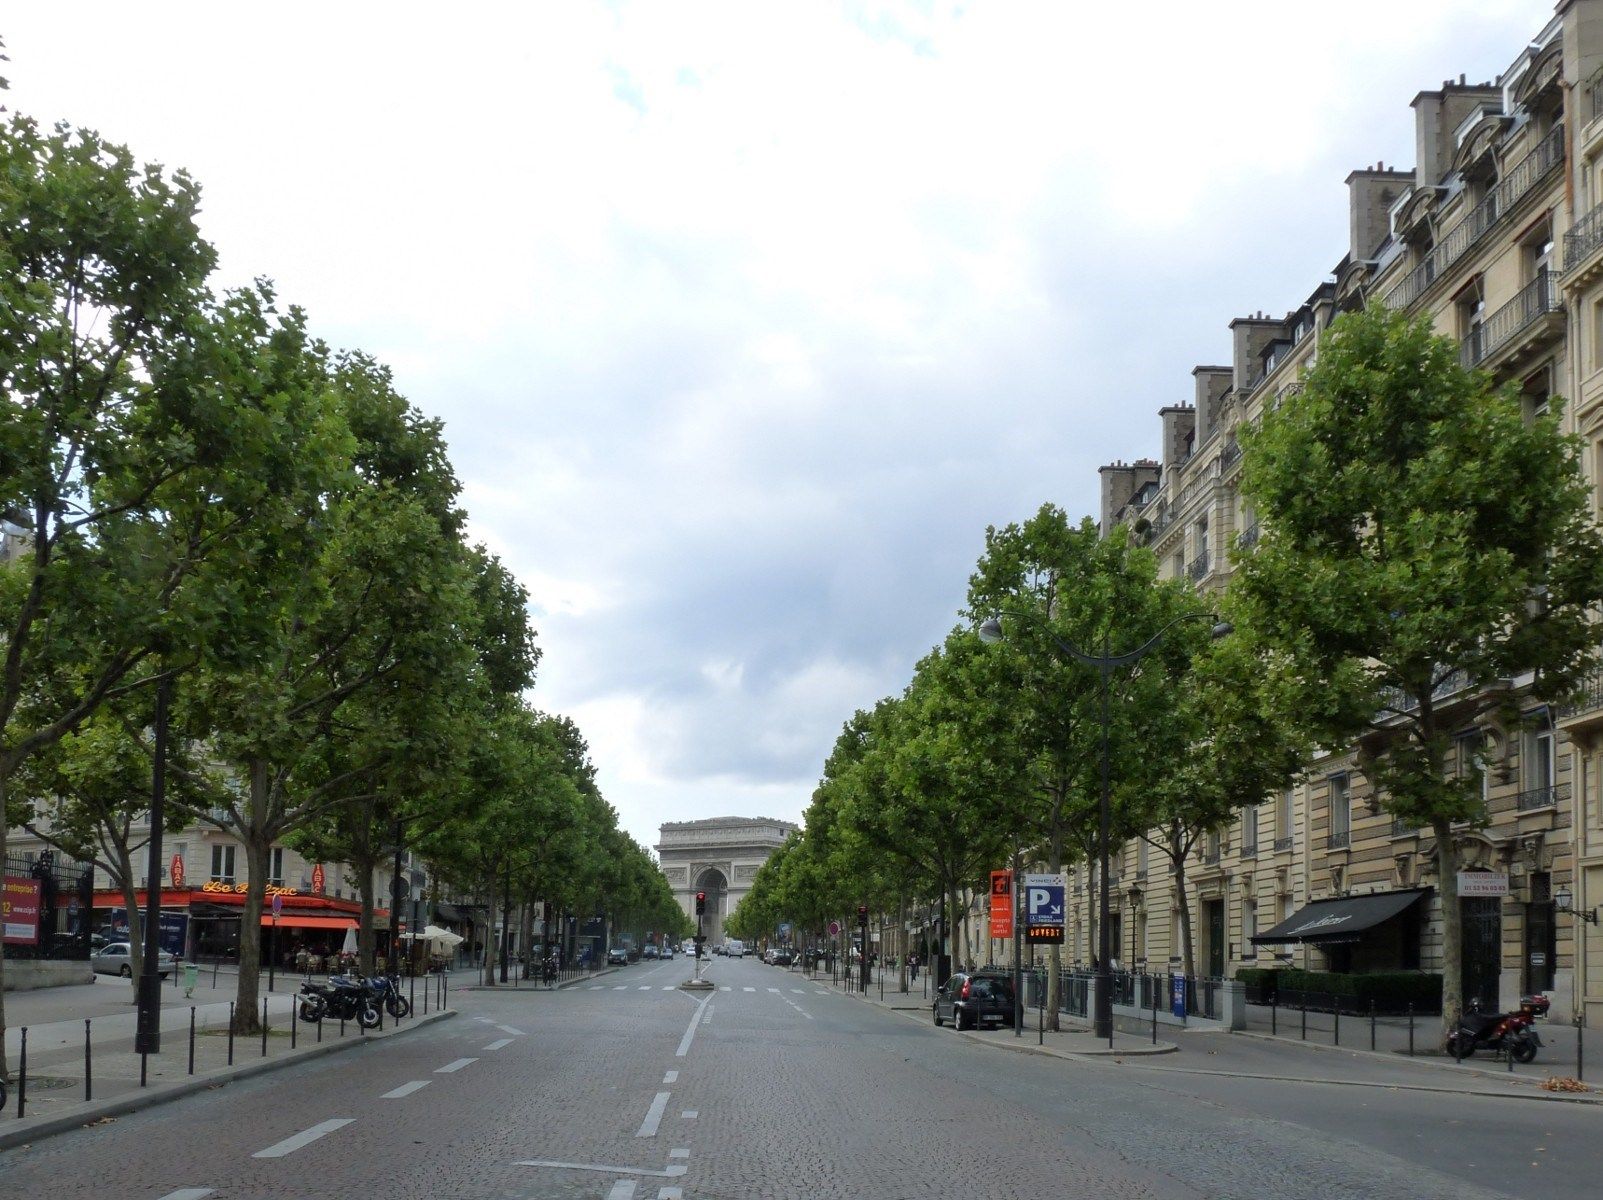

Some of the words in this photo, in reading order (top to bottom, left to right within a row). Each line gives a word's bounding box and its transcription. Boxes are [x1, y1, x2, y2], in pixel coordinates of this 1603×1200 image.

[174, 855, 182, 886] TABAC
[314, 863, 322, 893] TABAC
[202, 881, 233, 893] Le
[1030, 889, 1051, 914] P
